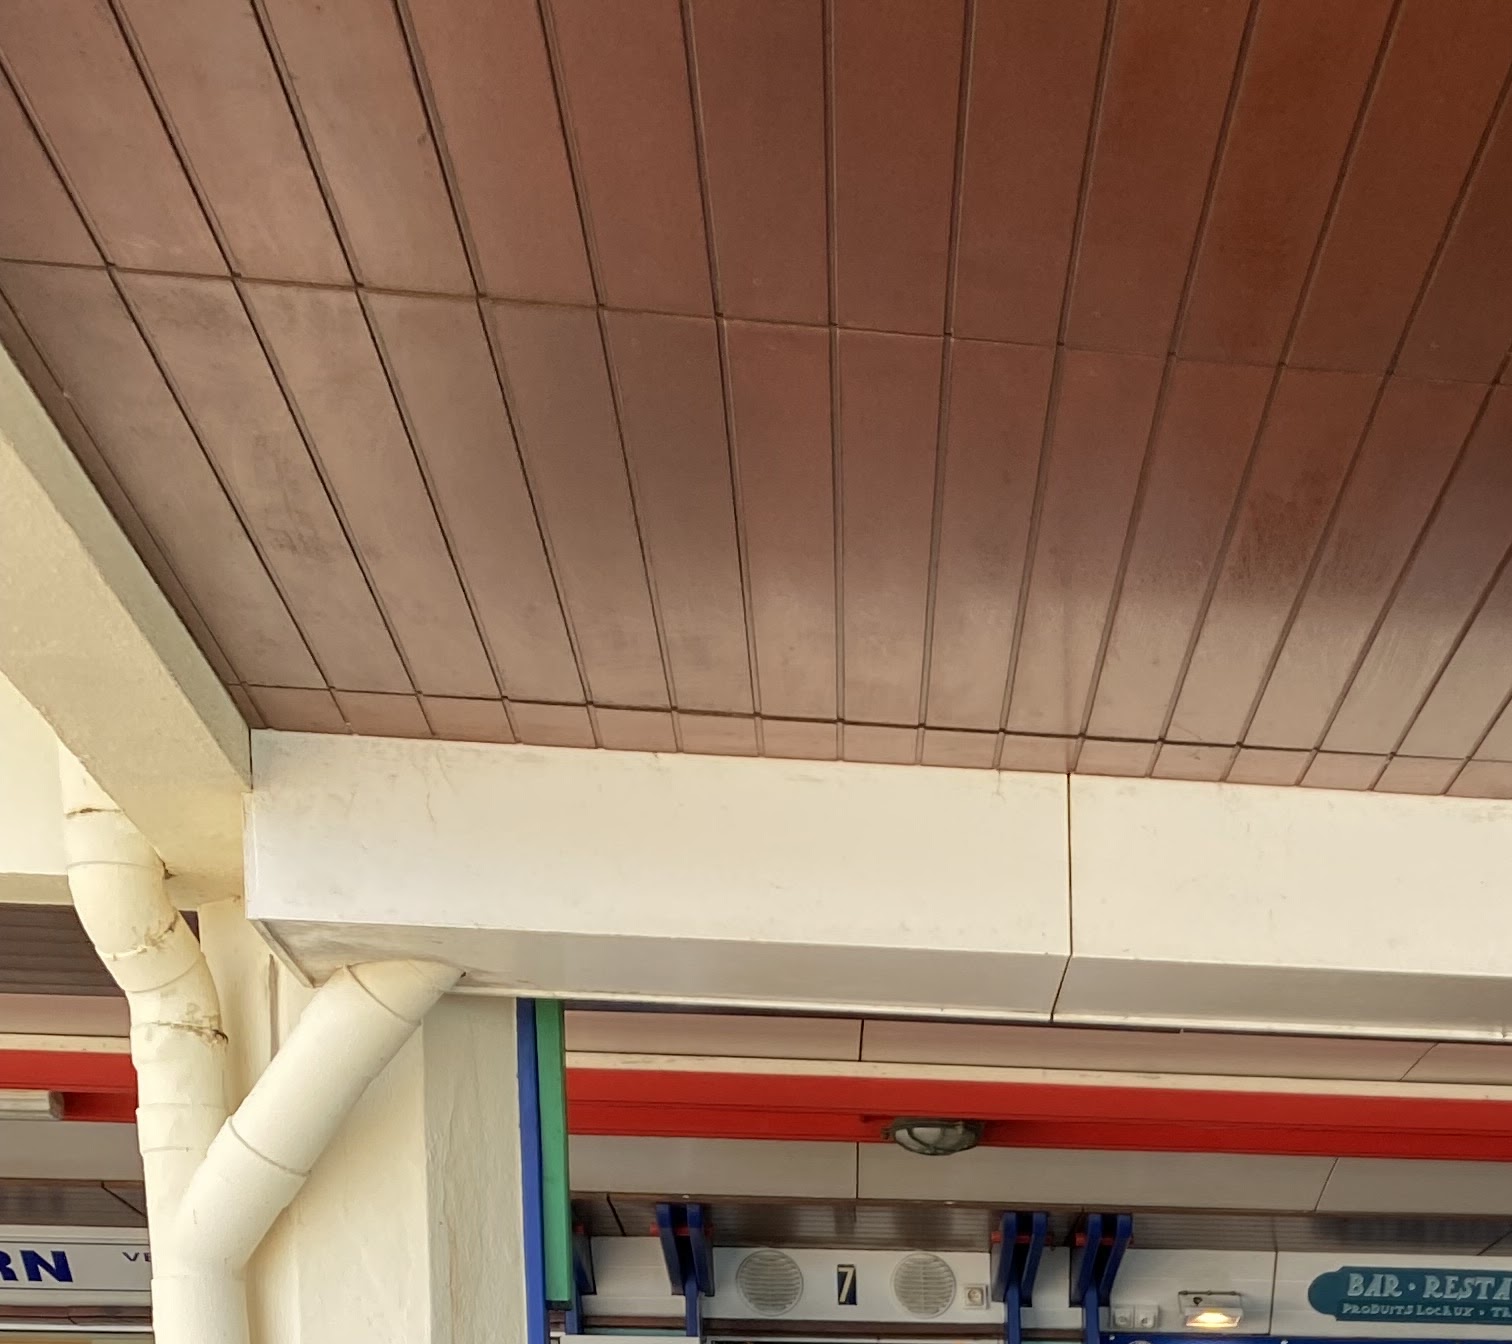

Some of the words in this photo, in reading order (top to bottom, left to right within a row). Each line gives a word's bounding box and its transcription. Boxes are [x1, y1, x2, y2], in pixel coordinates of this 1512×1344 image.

[838, 1265, 856, 1304] 7
[1347, 1272, 1403, 1298] BAR
[1342, 1303, 1414, 1316] PRODUITS
[1416, 1304, 1475, 1317] LOCAUX
